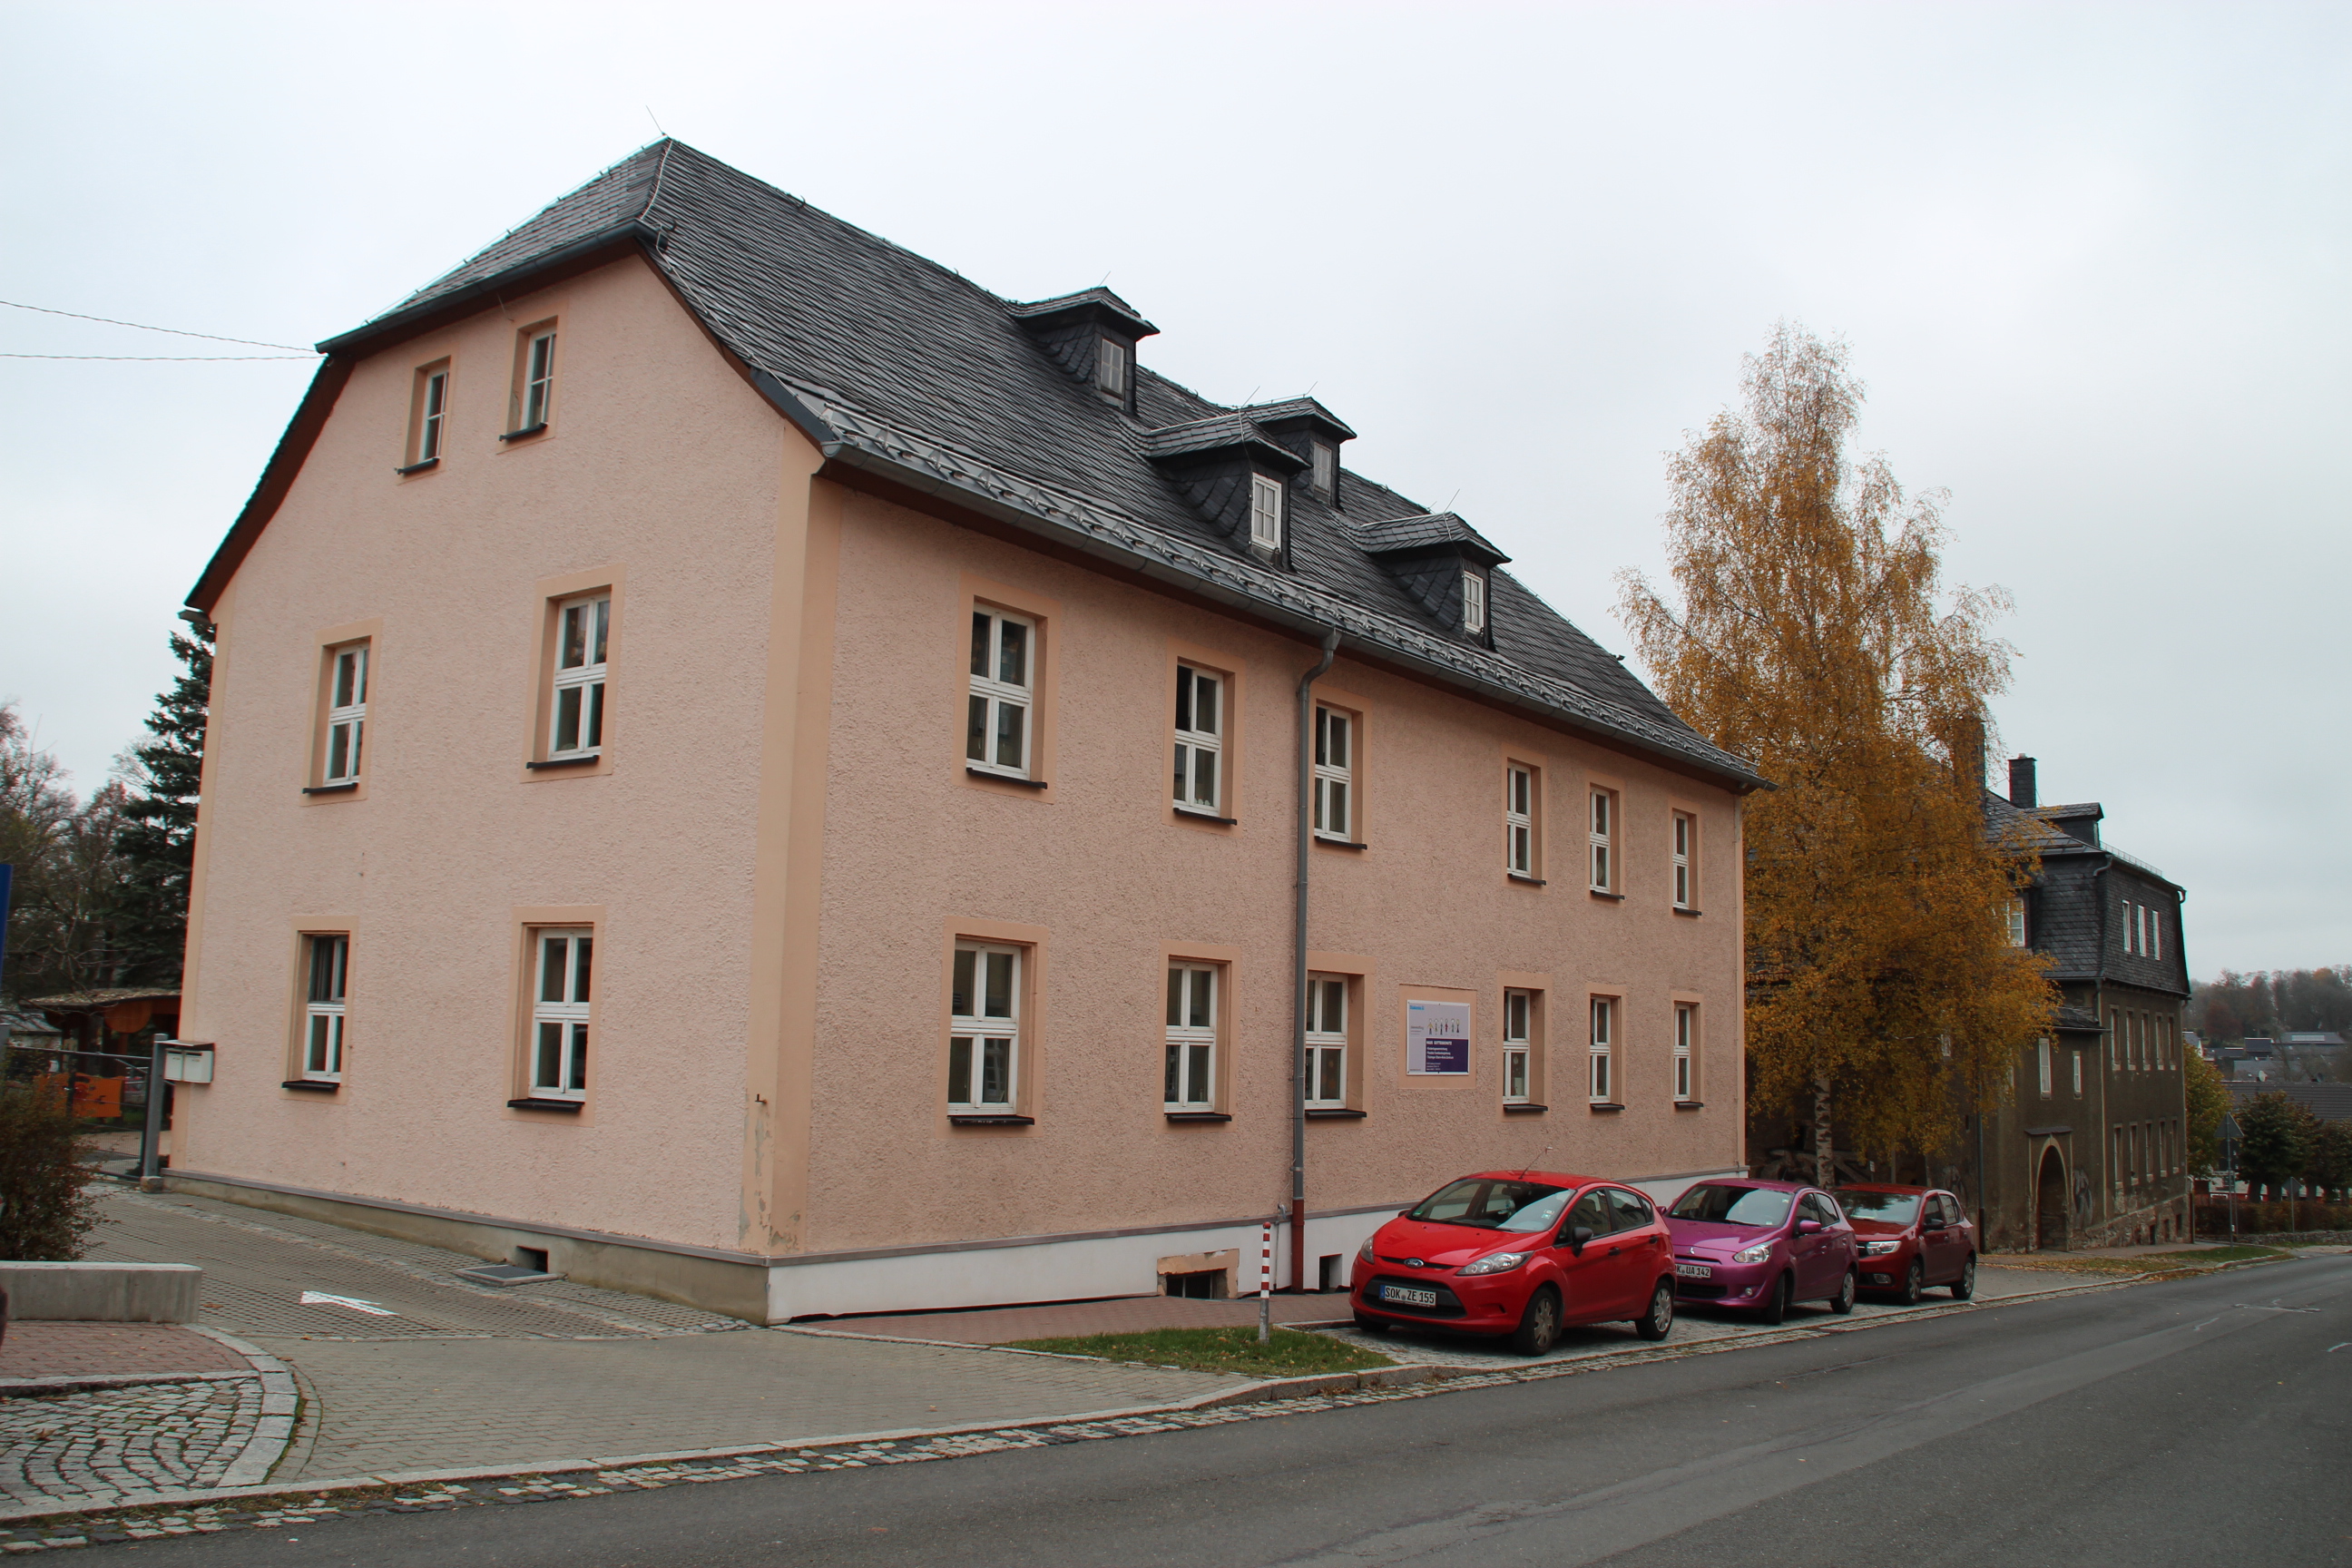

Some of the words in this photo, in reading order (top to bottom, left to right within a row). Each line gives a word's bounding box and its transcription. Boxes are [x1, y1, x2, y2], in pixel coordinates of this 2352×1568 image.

[1686, 1266, 1695, 1275] UA
[1696, 1267, 1710, 1277] 142
[1385, 1287, 1401, 1299] SOK
[1406, 1289, 1417, 1302] ZE
[1418, 1292, 1435, 1304] 155
